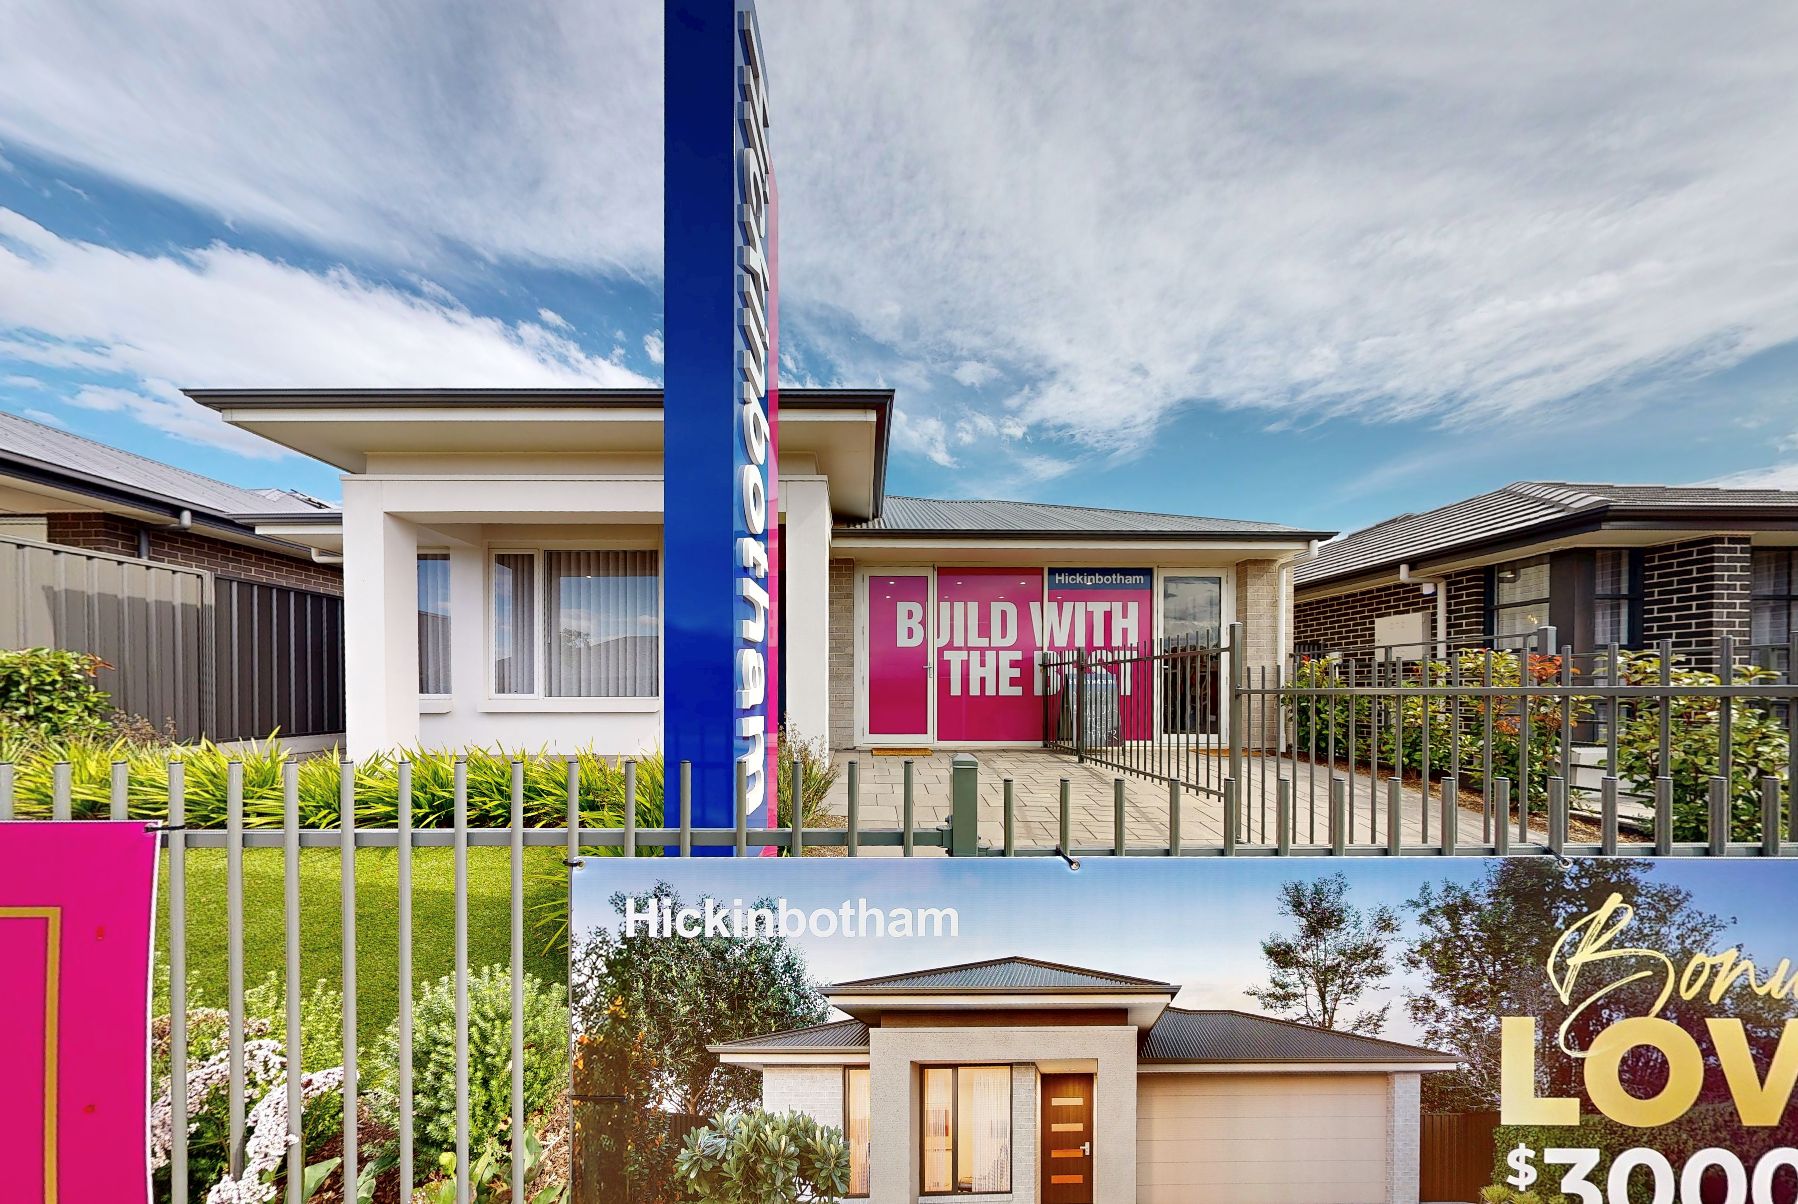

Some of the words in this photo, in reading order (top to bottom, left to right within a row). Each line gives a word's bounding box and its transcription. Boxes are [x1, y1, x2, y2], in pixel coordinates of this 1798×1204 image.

[742, 10, 769, 816] Hickinbotham
[1055, 572, 1144, 586] Hickinbotham
[897, 601, 1018, 647] BUILD
[1029, 601, 1139, 648] WITH
[944, 650, 1023, 696] THE
[624, 897, 959, 939] Hickinbotham
[1501, 1017, 1798, 1127] LOV
